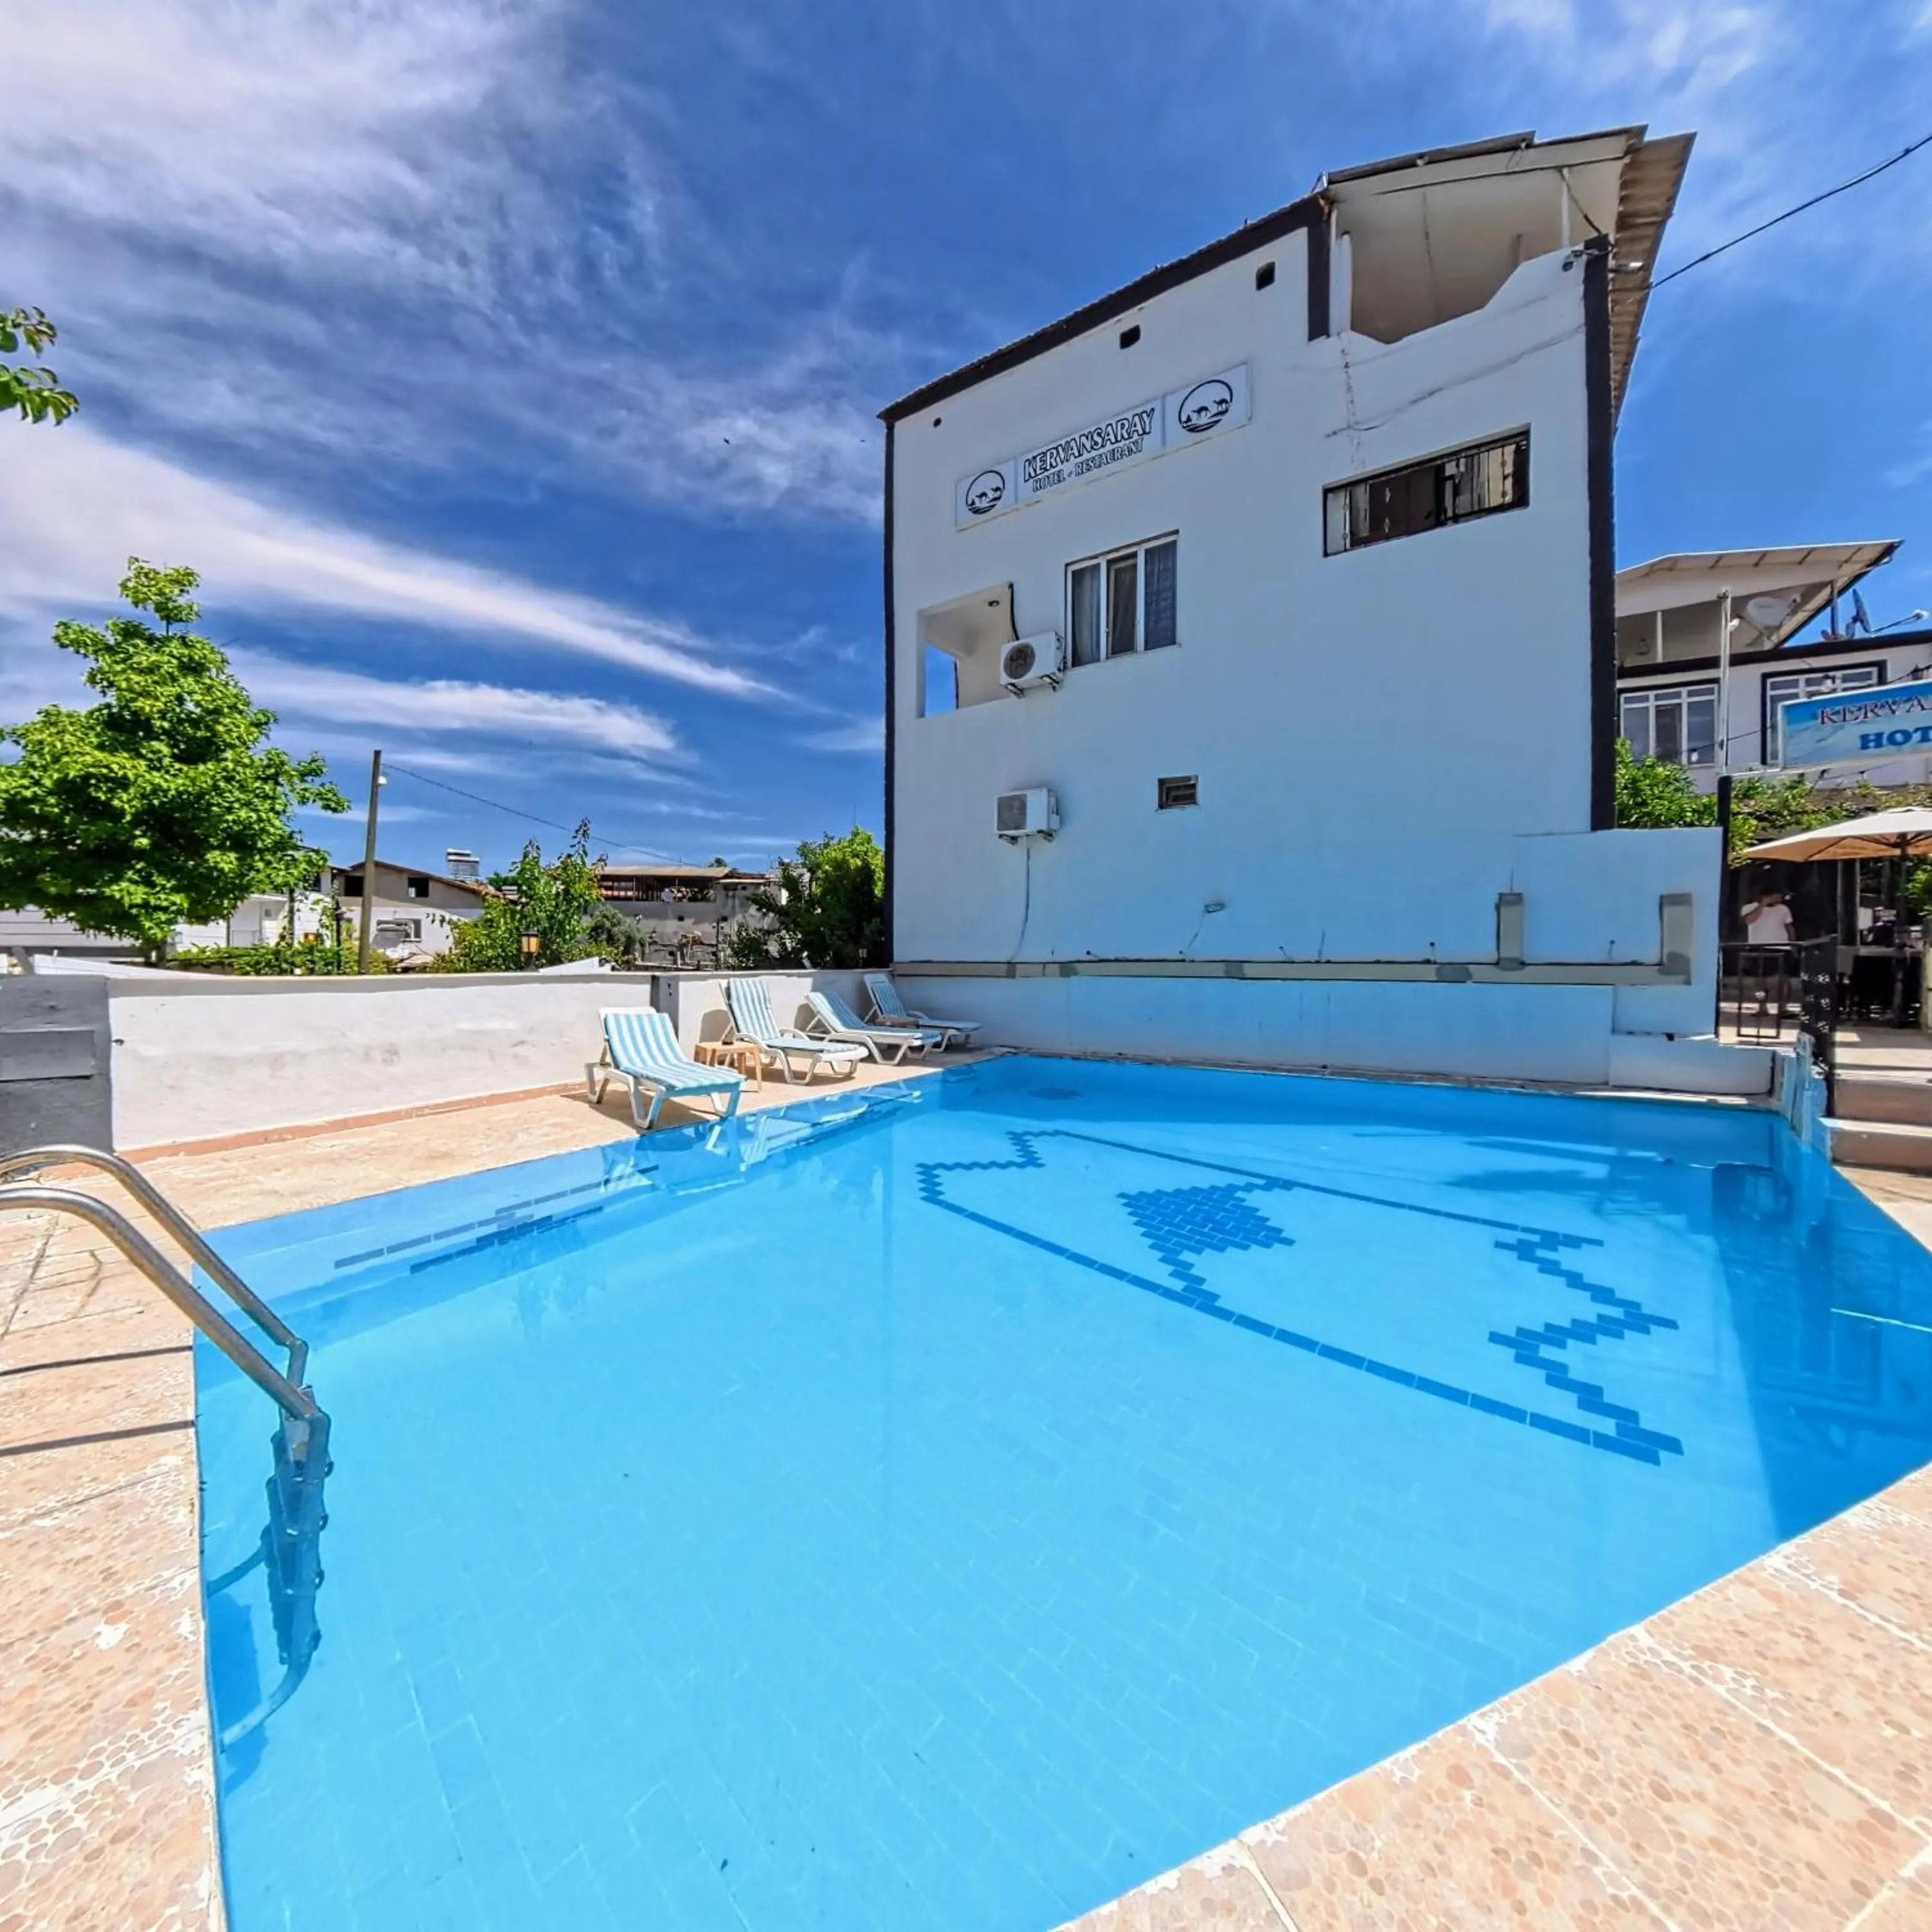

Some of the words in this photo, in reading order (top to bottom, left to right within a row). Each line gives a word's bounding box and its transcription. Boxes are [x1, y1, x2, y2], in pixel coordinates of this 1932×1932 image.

[1023, 406, 1156, 483] KERVANSARAY
[1032, 469, 1066, 493] HOTEL
[1075, 438, 1144, 477] RESTAURANT
